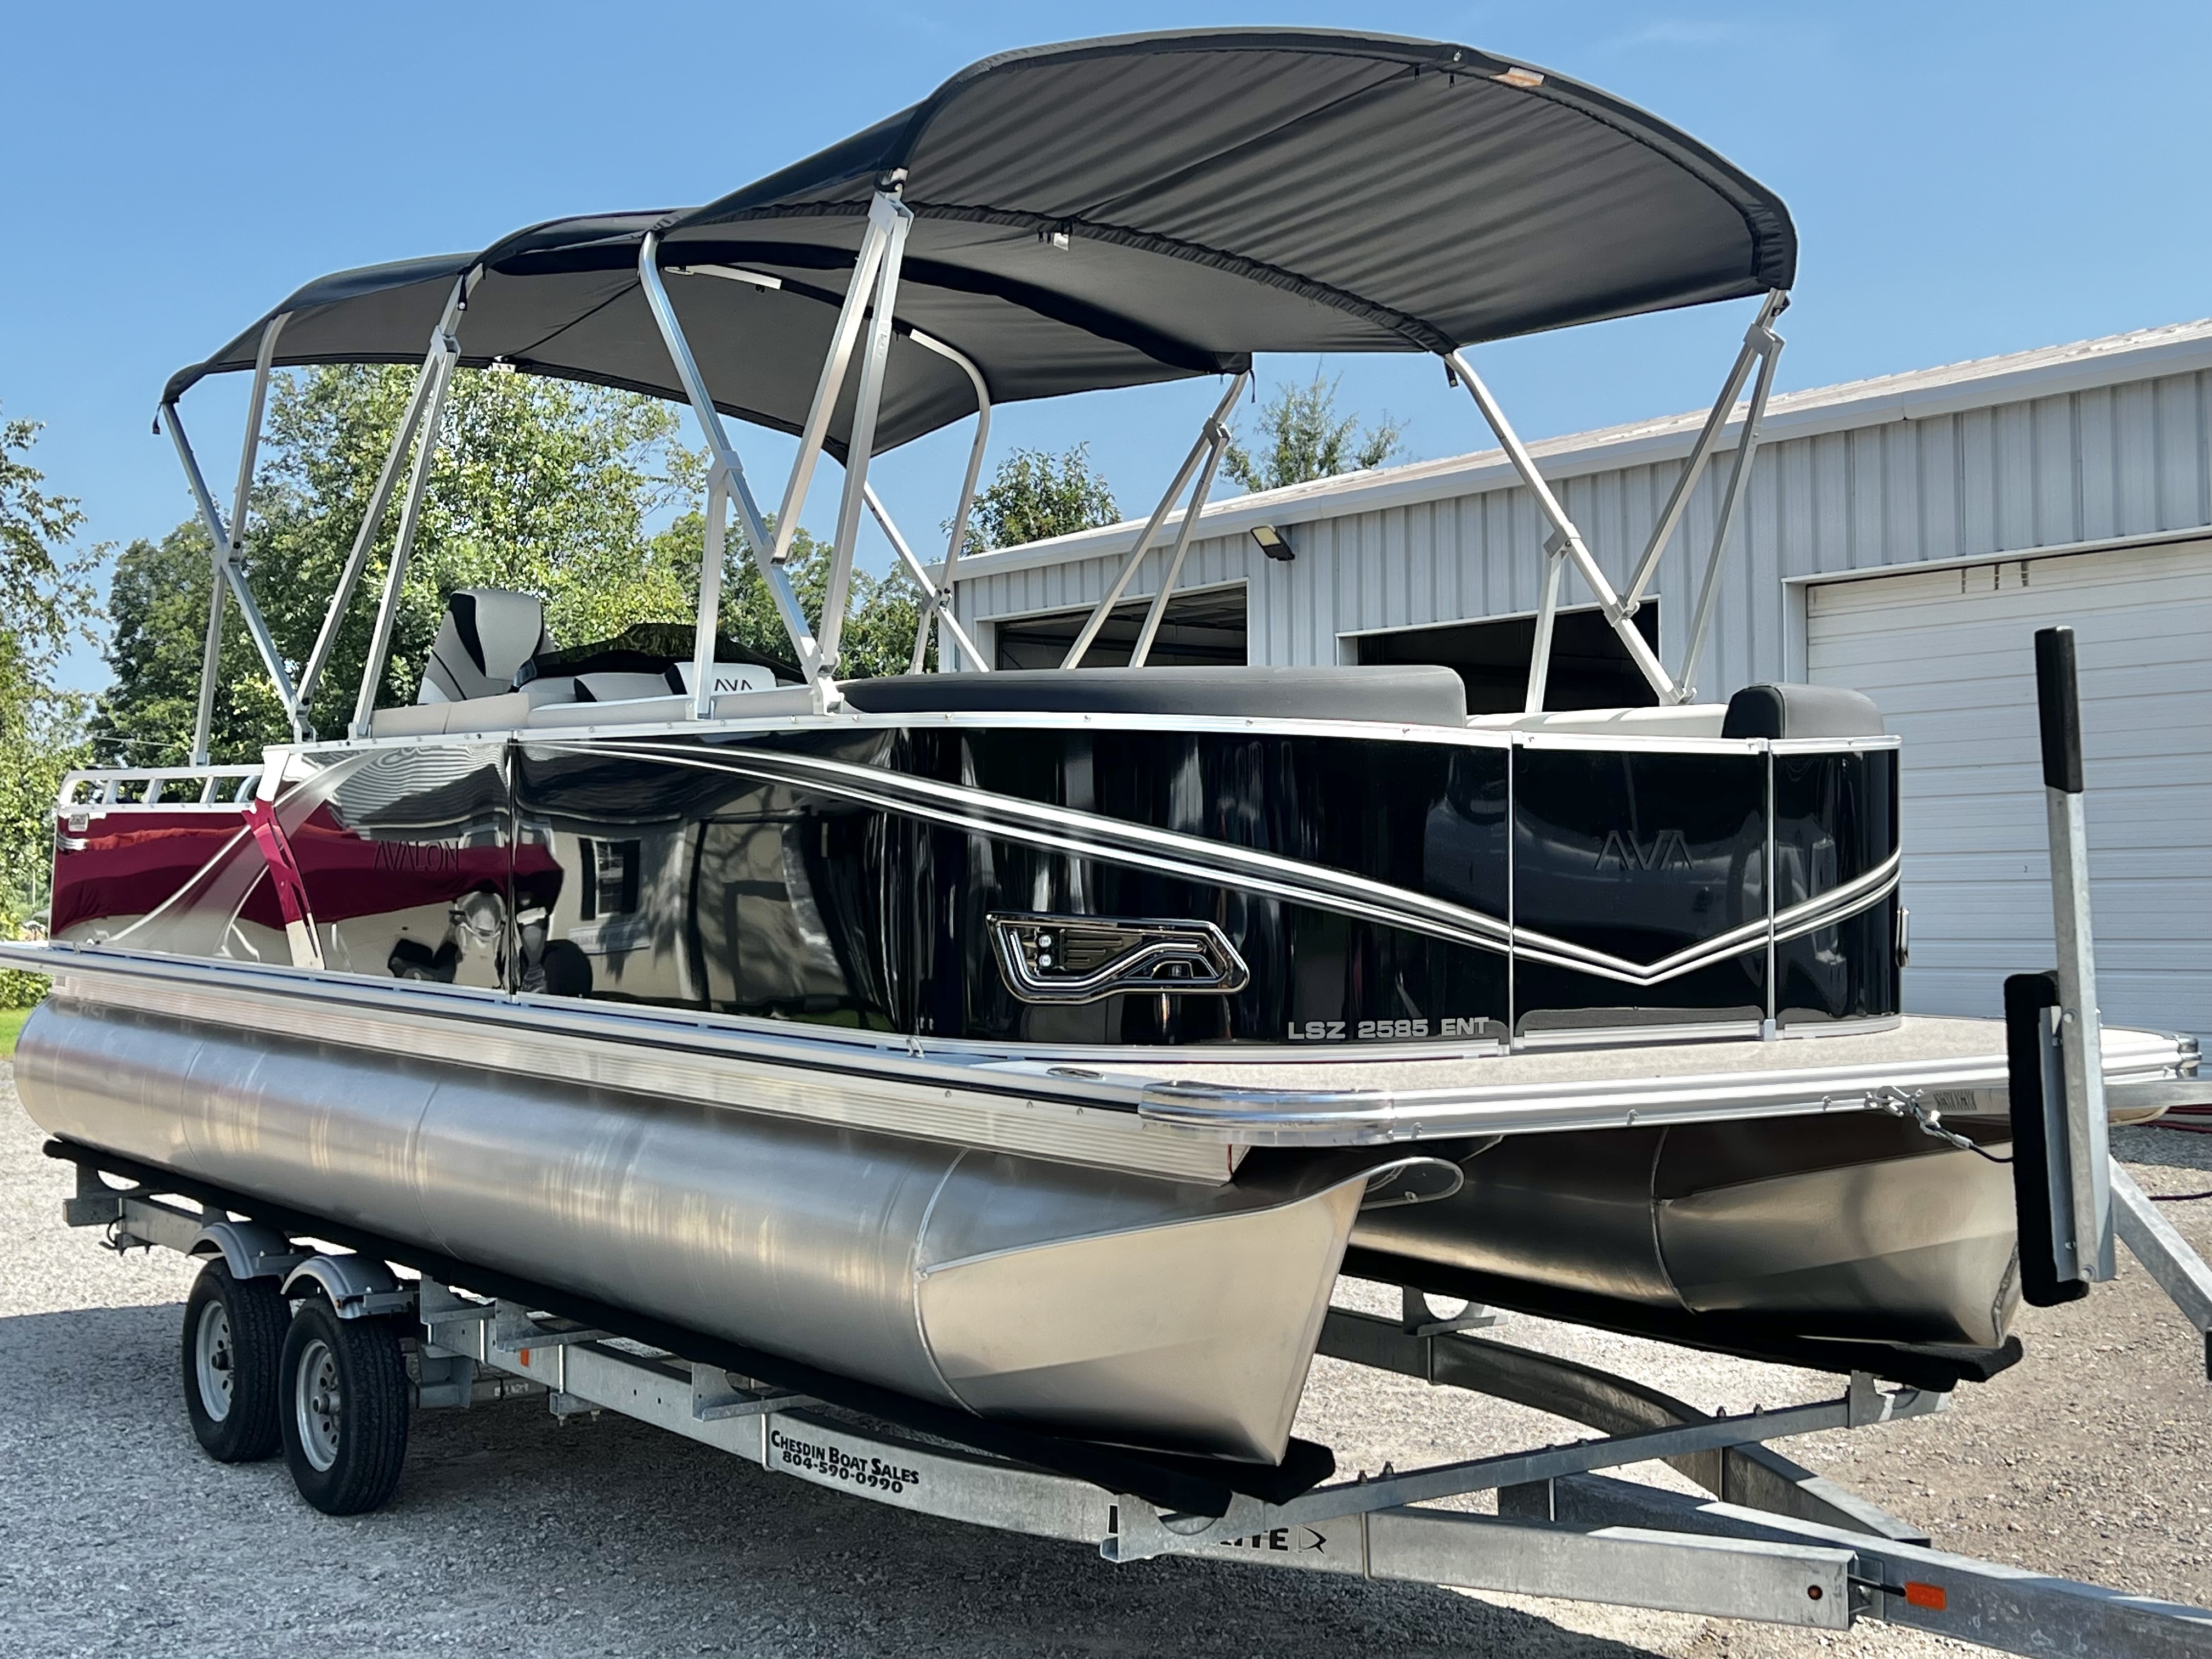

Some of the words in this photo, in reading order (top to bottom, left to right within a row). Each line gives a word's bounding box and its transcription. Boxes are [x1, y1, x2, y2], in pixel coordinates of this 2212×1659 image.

[715, 679, 753, 691] AVA
[374, 840, 459, 872] AVALON
[1594, 830, 1694, 871] AVA
[1288, 1022, 1346, 1039] LSZ
[1358, 1019, 1429, 1038] 2585
[1441, 1017, 1489, 1036] ENT
[782, 1451, 903, 1493] 804-590-0990
